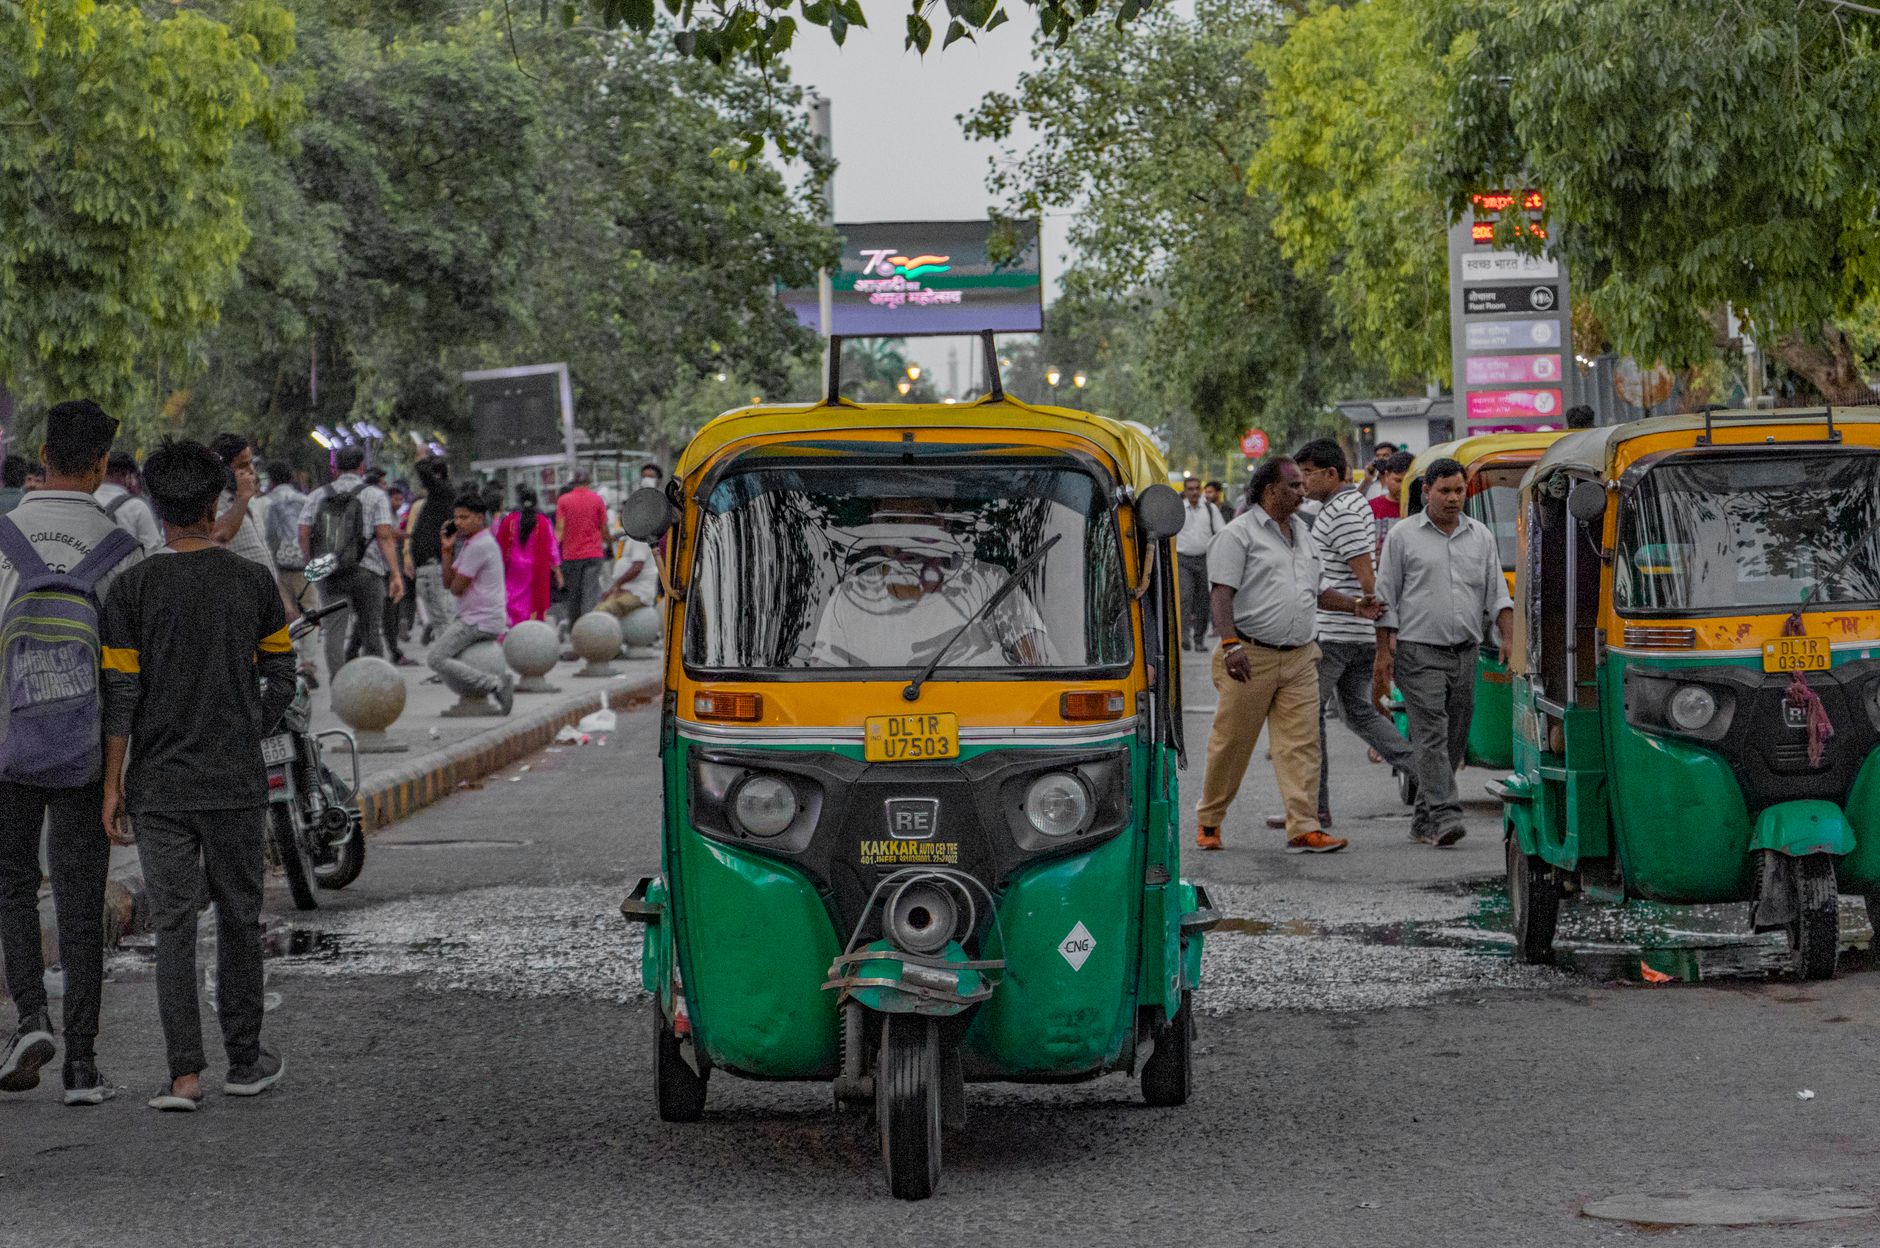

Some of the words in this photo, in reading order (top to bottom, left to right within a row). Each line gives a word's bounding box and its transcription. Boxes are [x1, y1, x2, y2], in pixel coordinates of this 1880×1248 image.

[1467, 259, 1492, 270] स्वच्छ
[1495, 258, 1518, 270] भारत
[1486, 301, 1506, 311] Room
[30, 531, 74, 546] COLLEGE
[1781, 639, 1817, 655] DL1R
[888, 715, 940, 737] DL1R
[884, 736, 949, 757] U7503
[896, 812, 929, 831] RE
[860, 841, 918, 855] KAKKAR
[919, 843, 934, 855] AUTO
[1065, 939, 1089, 953] CNG
